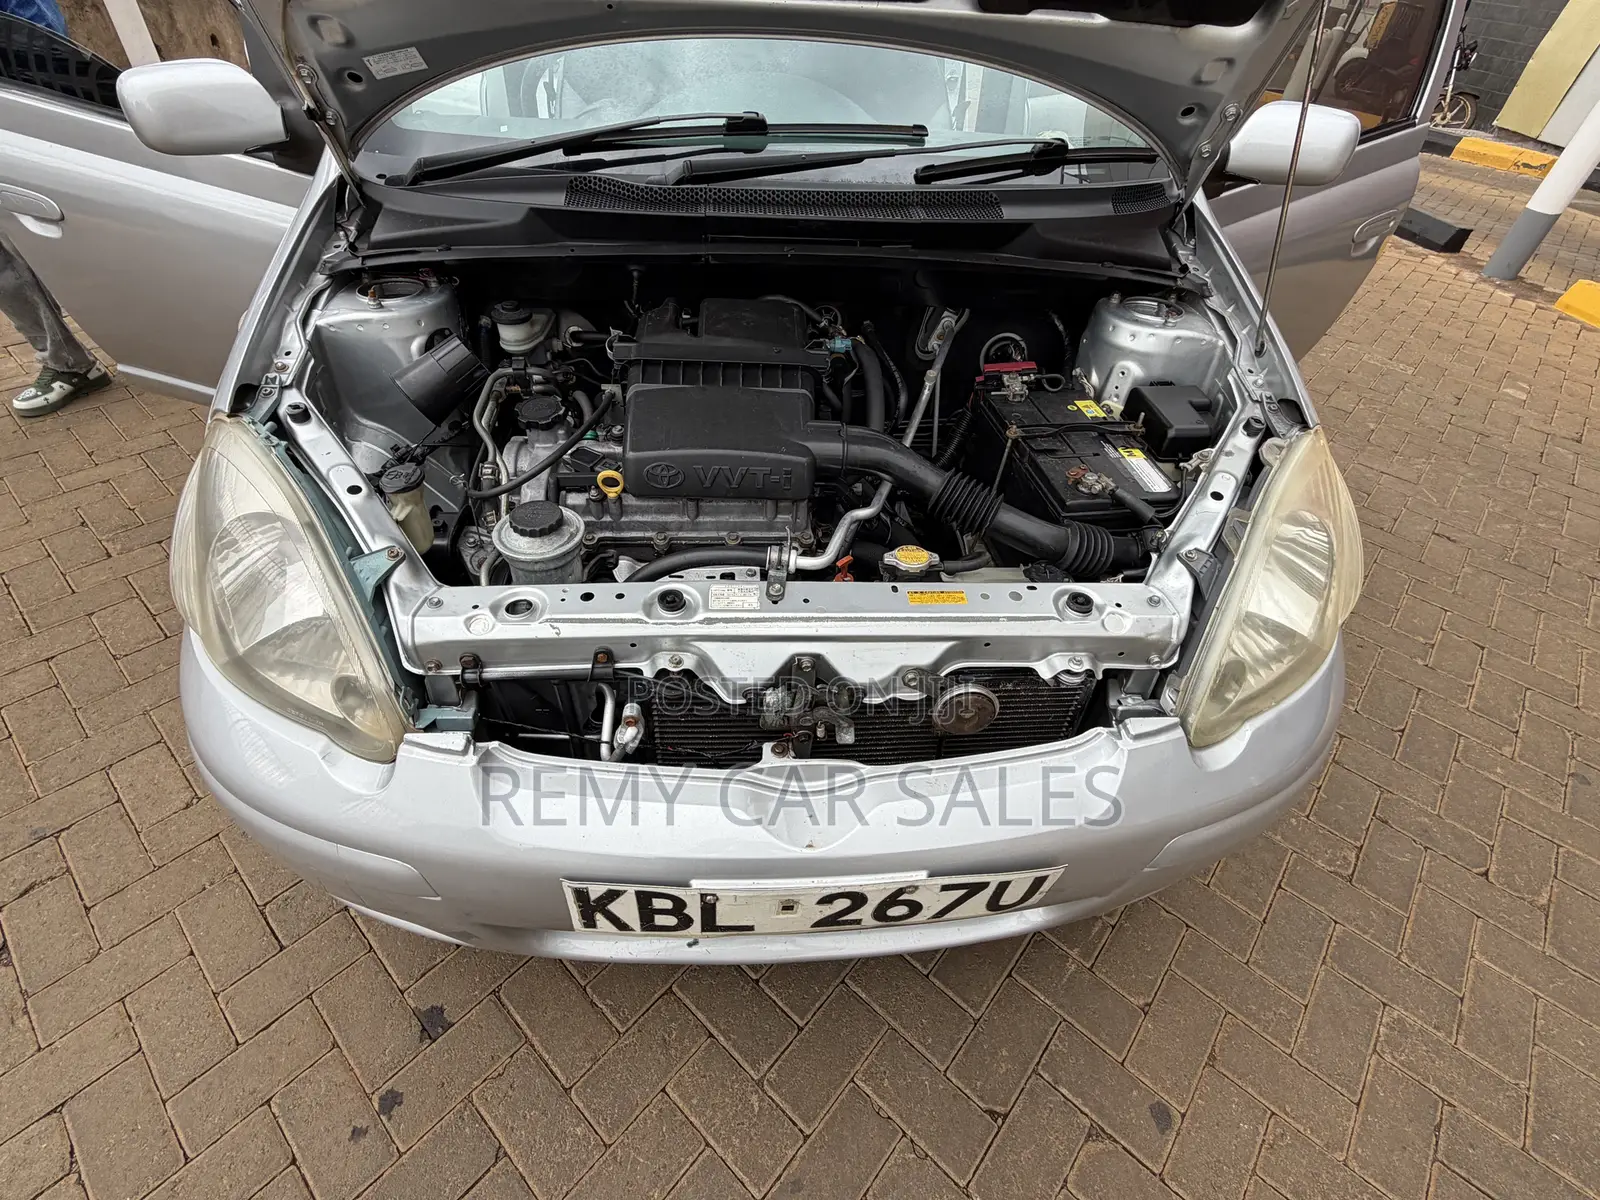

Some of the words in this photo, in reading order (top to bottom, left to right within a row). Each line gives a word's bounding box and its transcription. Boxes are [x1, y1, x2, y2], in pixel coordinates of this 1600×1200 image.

[693, 465, 792, 491] VVT-i
[568, 886, 756, 933] KBL
[810, 874, 1051, 929] 267U
